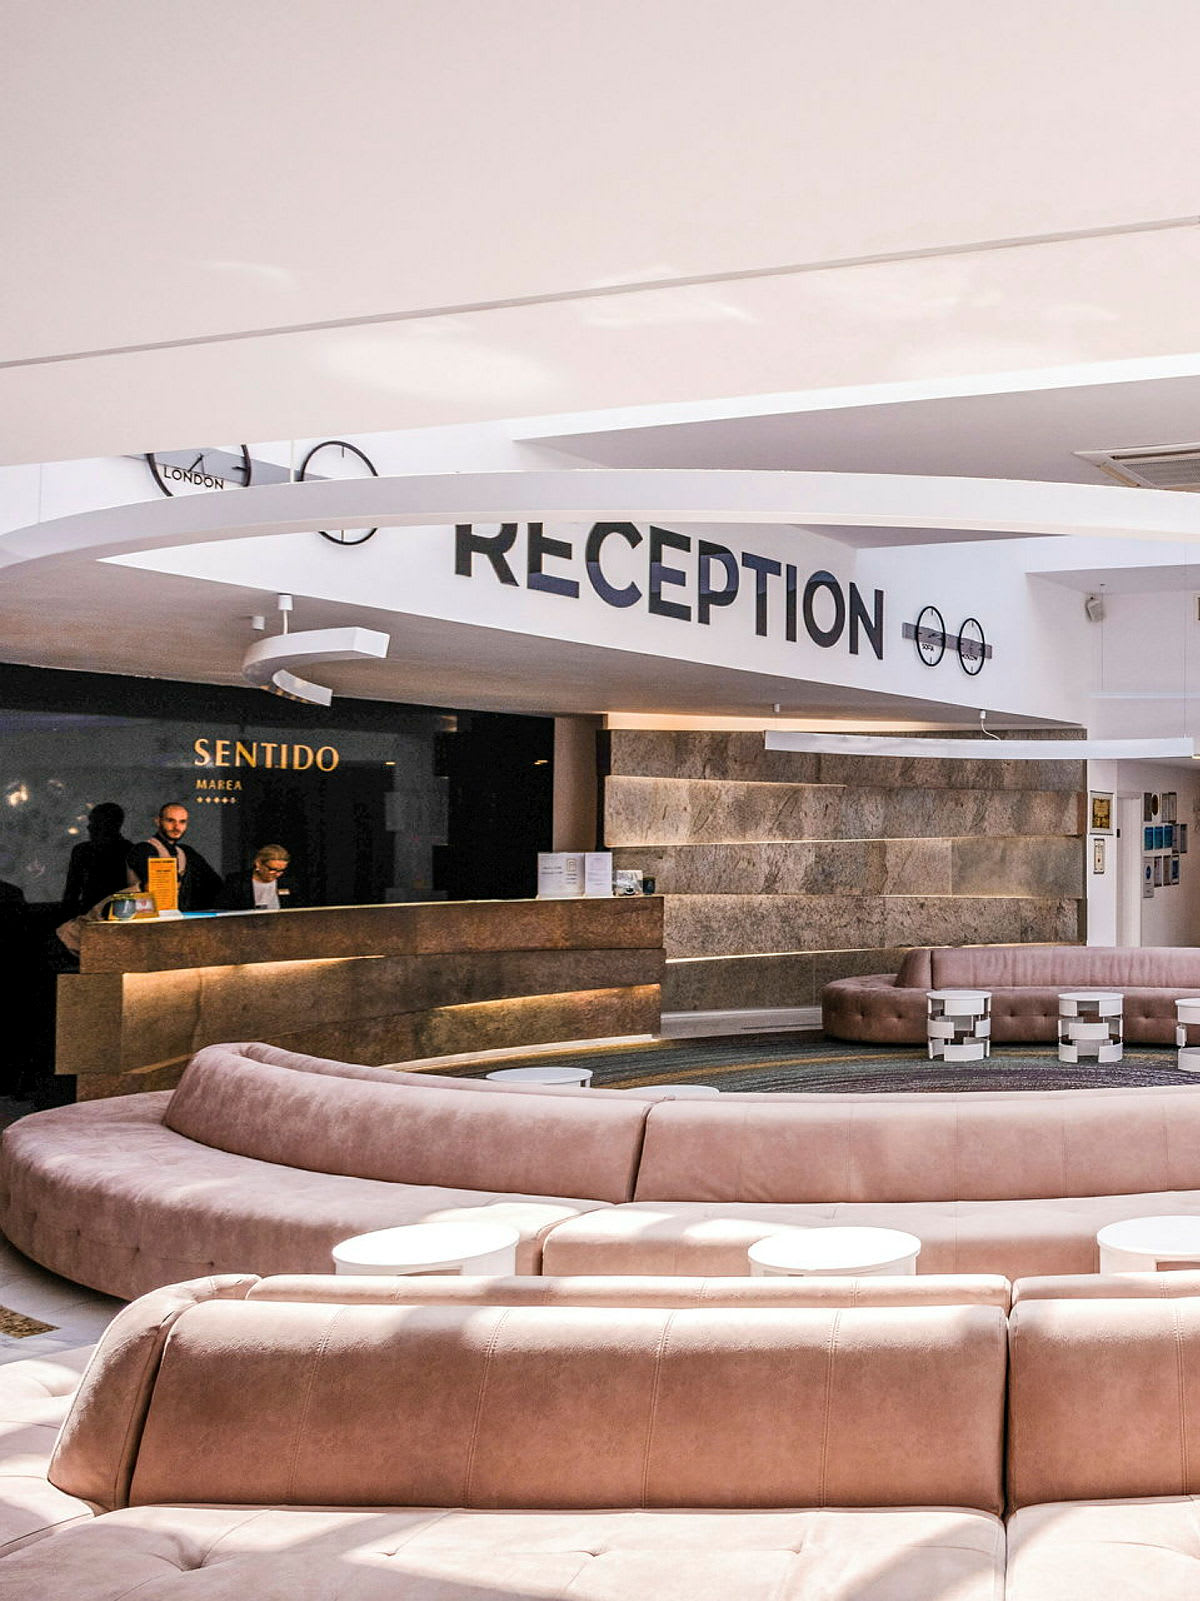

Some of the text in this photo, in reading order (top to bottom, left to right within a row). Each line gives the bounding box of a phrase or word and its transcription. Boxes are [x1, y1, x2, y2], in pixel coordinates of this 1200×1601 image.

[163, 464, 224, 490] LONDON
[455, 522, 884, 660] RECEPTION
[194, 738, 340, 771] SENTIDO
[196, 779, 243, 791] MAREA
